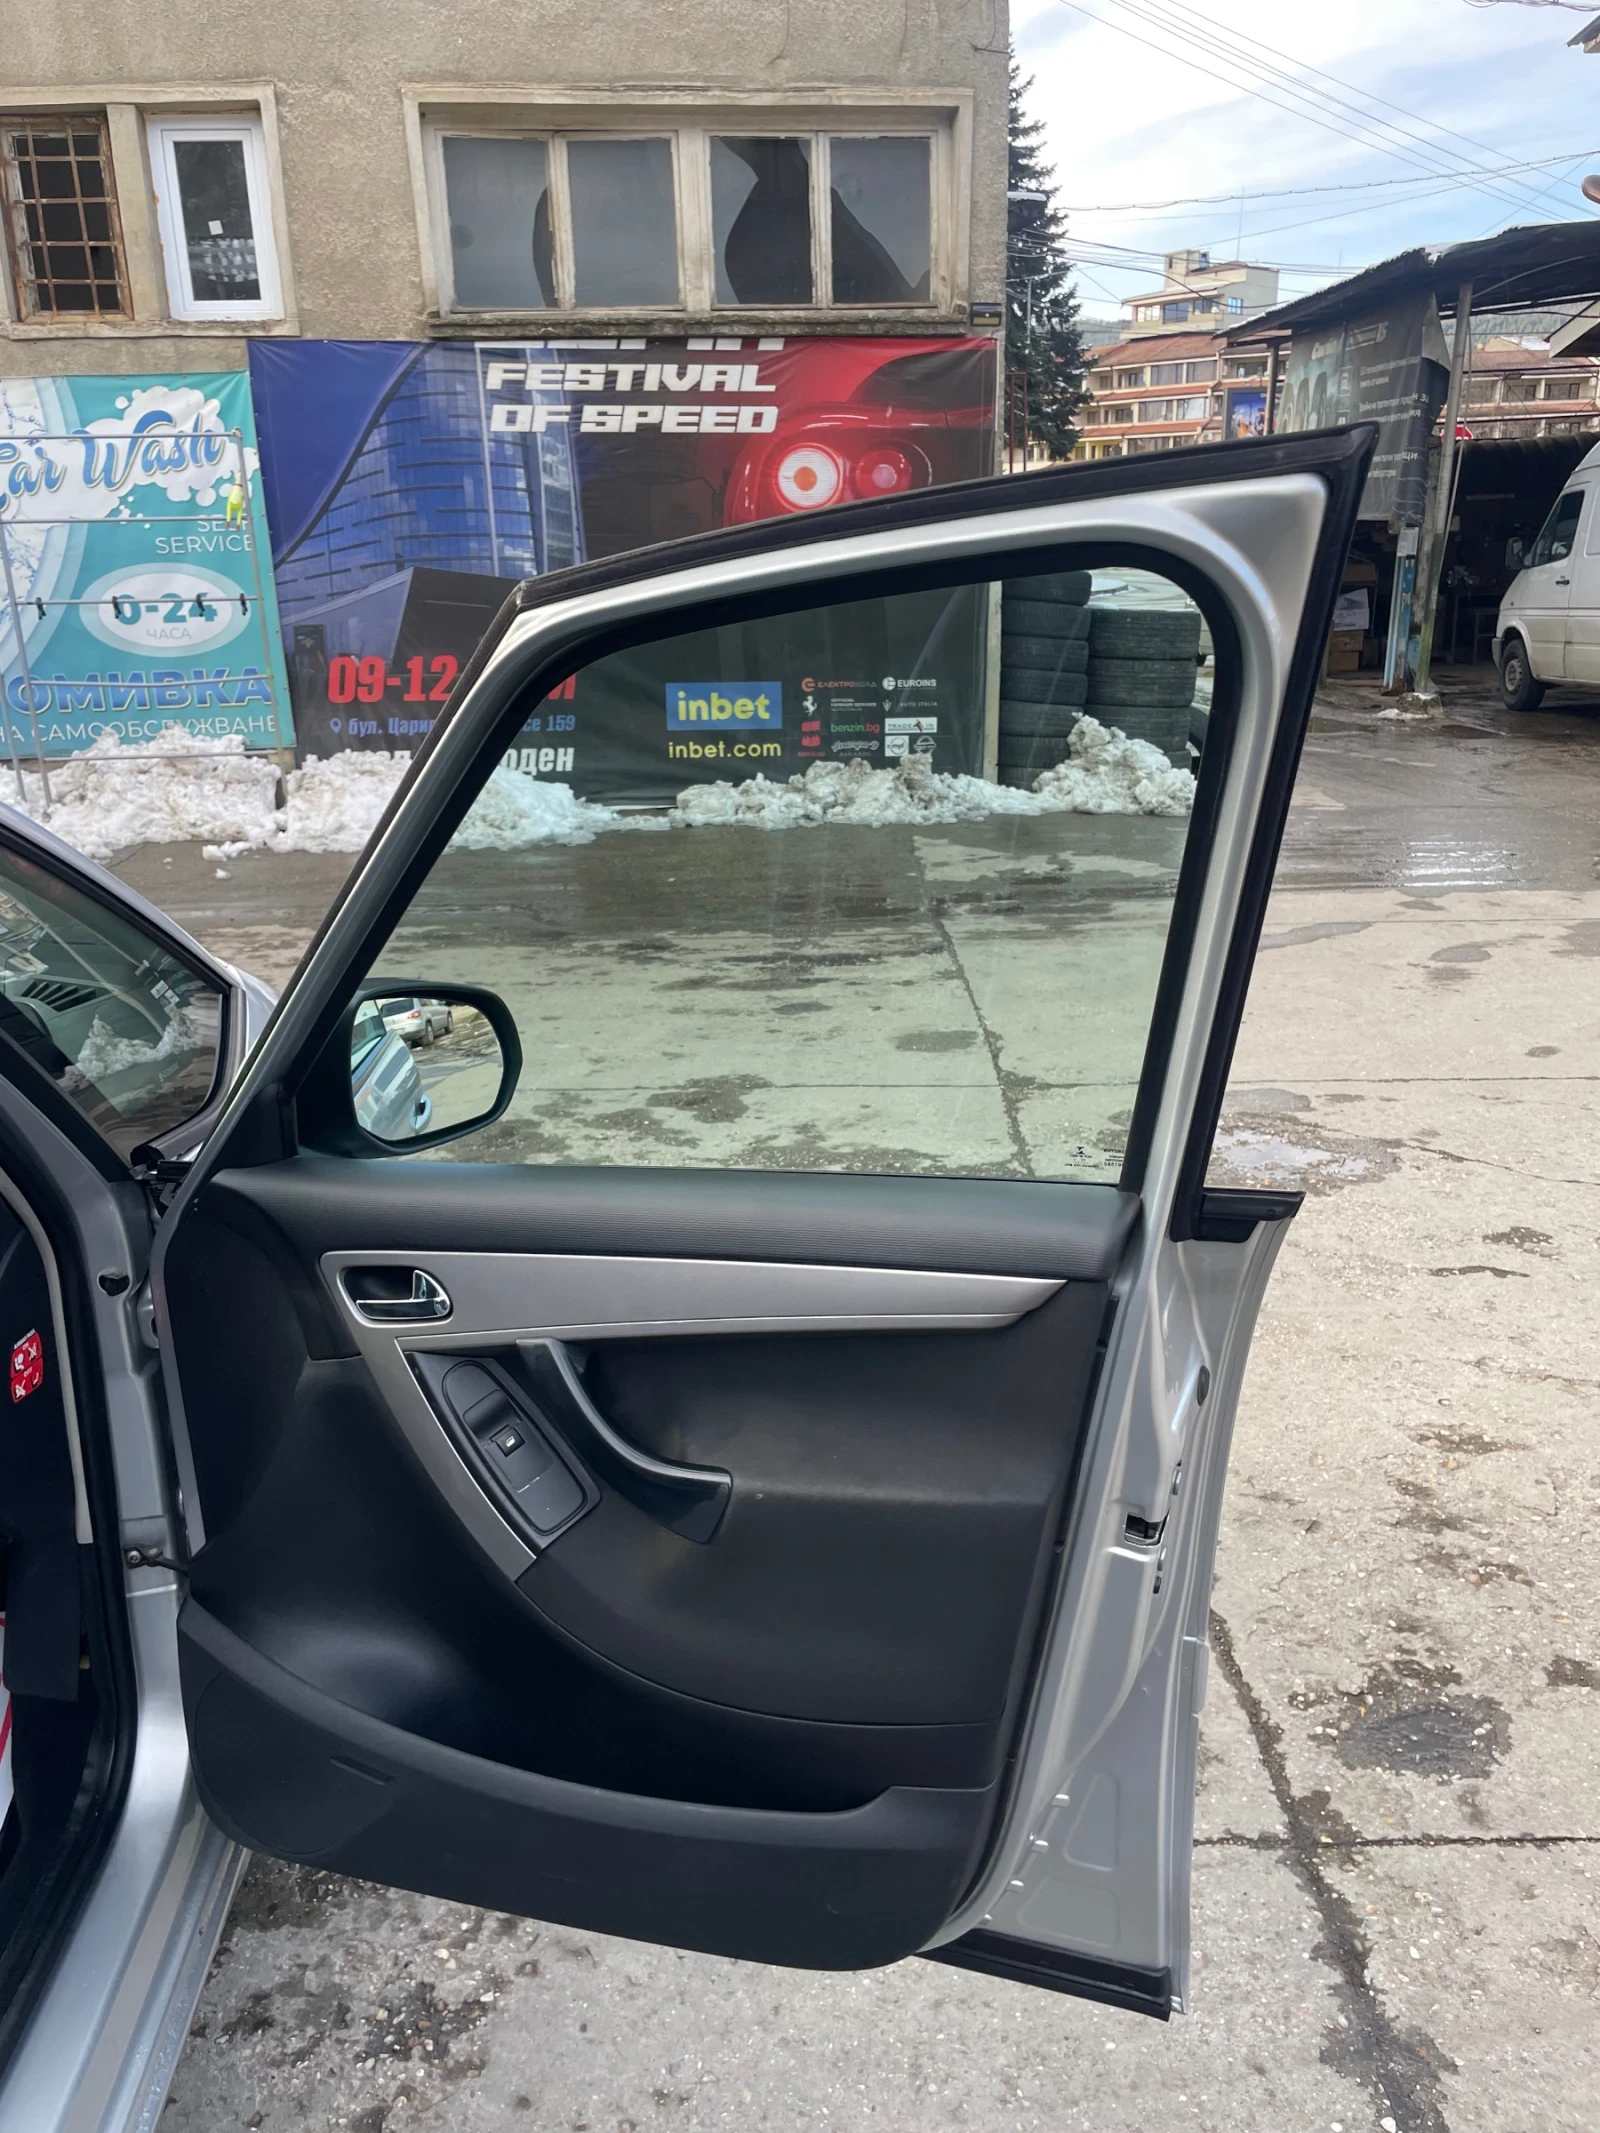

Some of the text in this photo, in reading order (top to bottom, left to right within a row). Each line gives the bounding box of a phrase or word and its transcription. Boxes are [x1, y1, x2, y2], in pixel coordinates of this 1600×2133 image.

[486, 363, 777, 392] FESTIVAL
[489, 405, 779, 433] OF SPEED
[72, 410, 226, 492] Wash
[155, 535, 252, 554] SERVICE
[116, 592, 218, 625] 0-24
[146, 627, 192, 640] ЧАСА
[7, 667, 273, 714] ОМИВКА
[328, 655, 458, 703] 09-12
[897, 679, 937, 688] EUROINS
[677, 691, 771, 720] inbet
[348, 718, 383, 737] бул.
[546, 715, 577, 732] 159
[830, 722, 880, 733] benzin.bg
[668, 741, 782, 758] inbet.com
